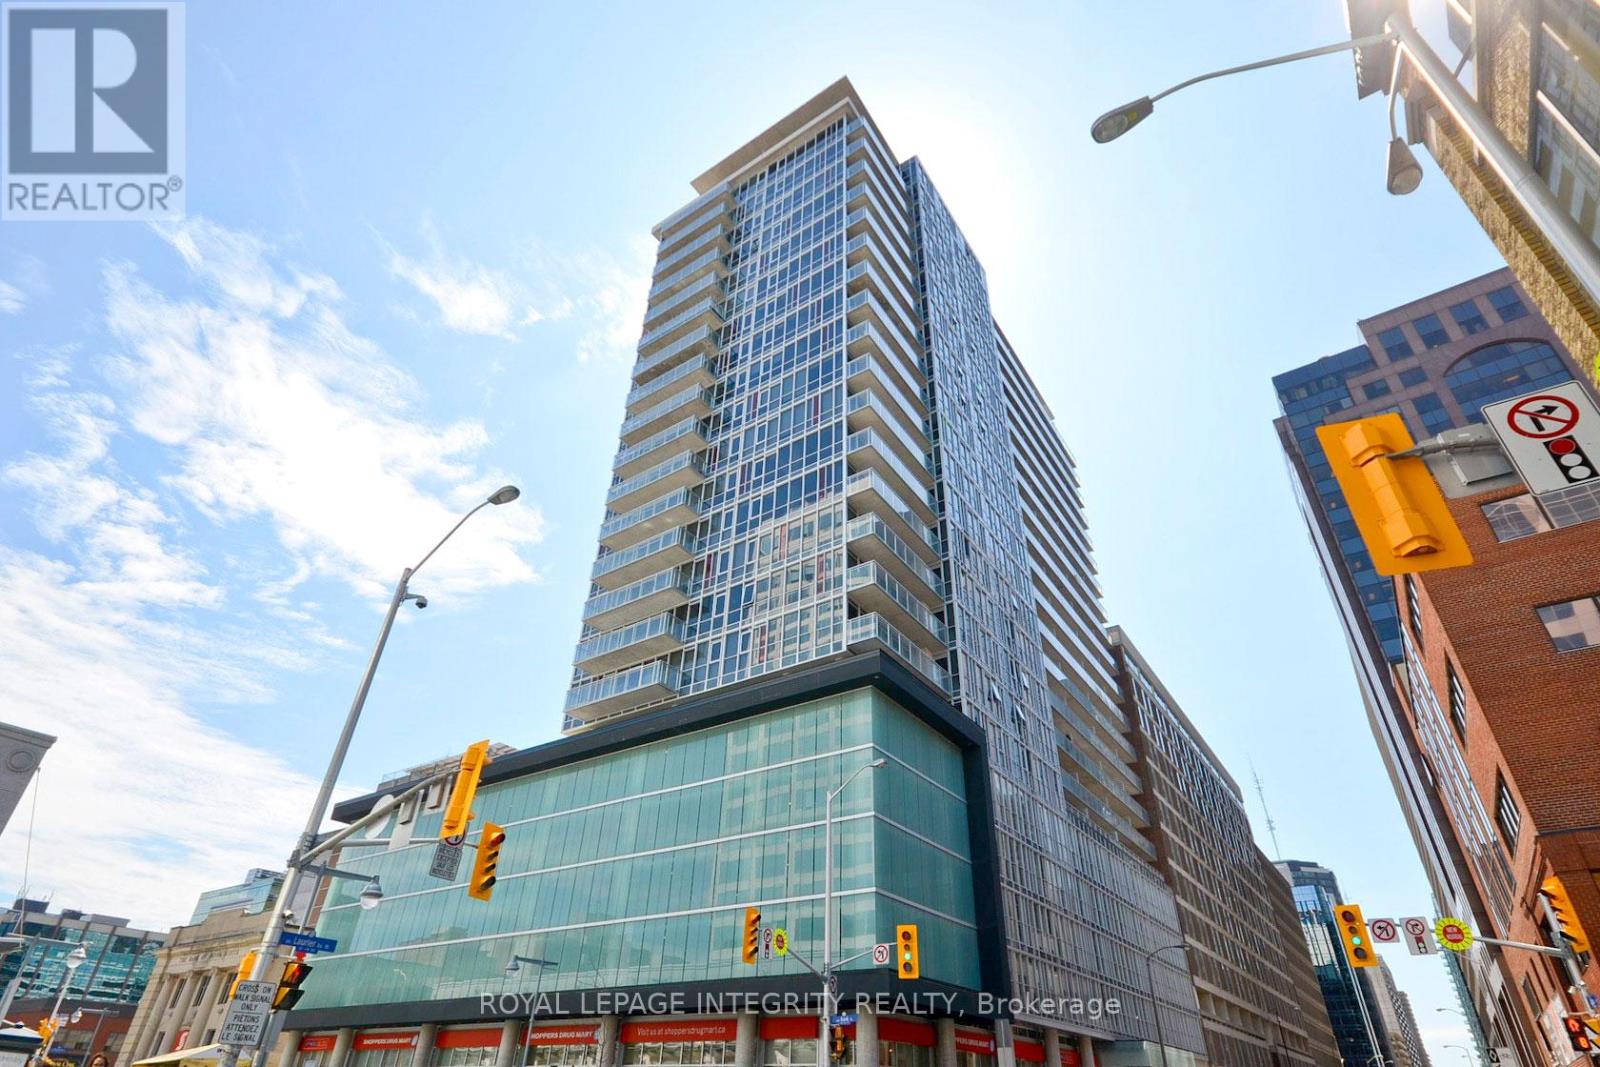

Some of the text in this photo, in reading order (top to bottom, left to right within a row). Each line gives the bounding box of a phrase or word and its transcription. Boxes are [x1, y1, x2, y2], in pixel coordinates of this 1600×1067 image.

[239, 983, 272, 994] CROSS ON
[249, 994, 272, 1003] SIGNAL
[241, 1002, 259, 1011] ONLY
[225, 1023, 260, 1033] ATTENDEZ
[221, 1032, 256, 1042] LE SIGNAL
